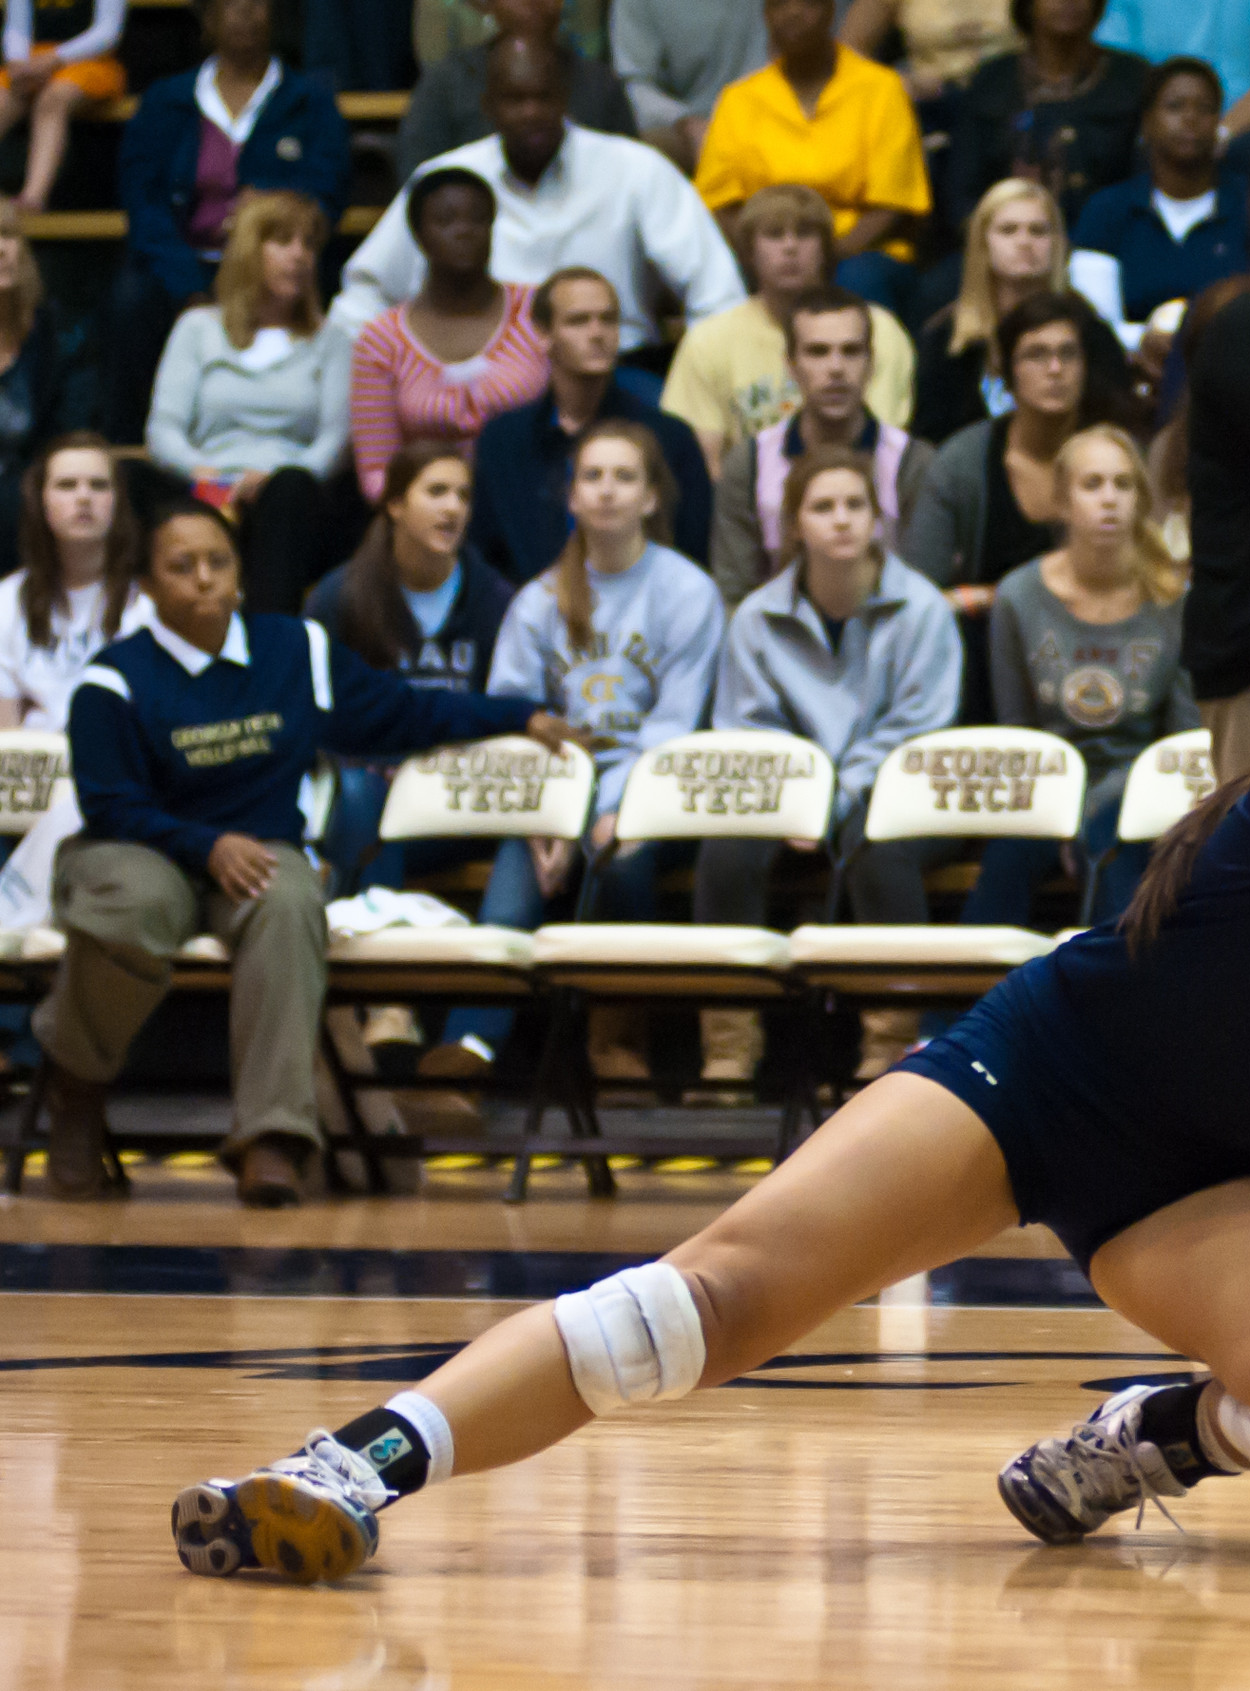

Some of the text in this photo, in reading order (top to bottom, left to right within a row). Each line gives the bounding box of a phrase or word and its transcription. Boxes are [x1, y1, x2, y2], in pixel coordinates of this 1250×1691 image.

[653, 749, 815, 780] GEORGIA
[901, 747, 1067, 778] GEORGIA
[443, 779, 545, 812] TECH
[677, 780, 784, 814] TECH
[929, 778, 1036, 813] TECH
